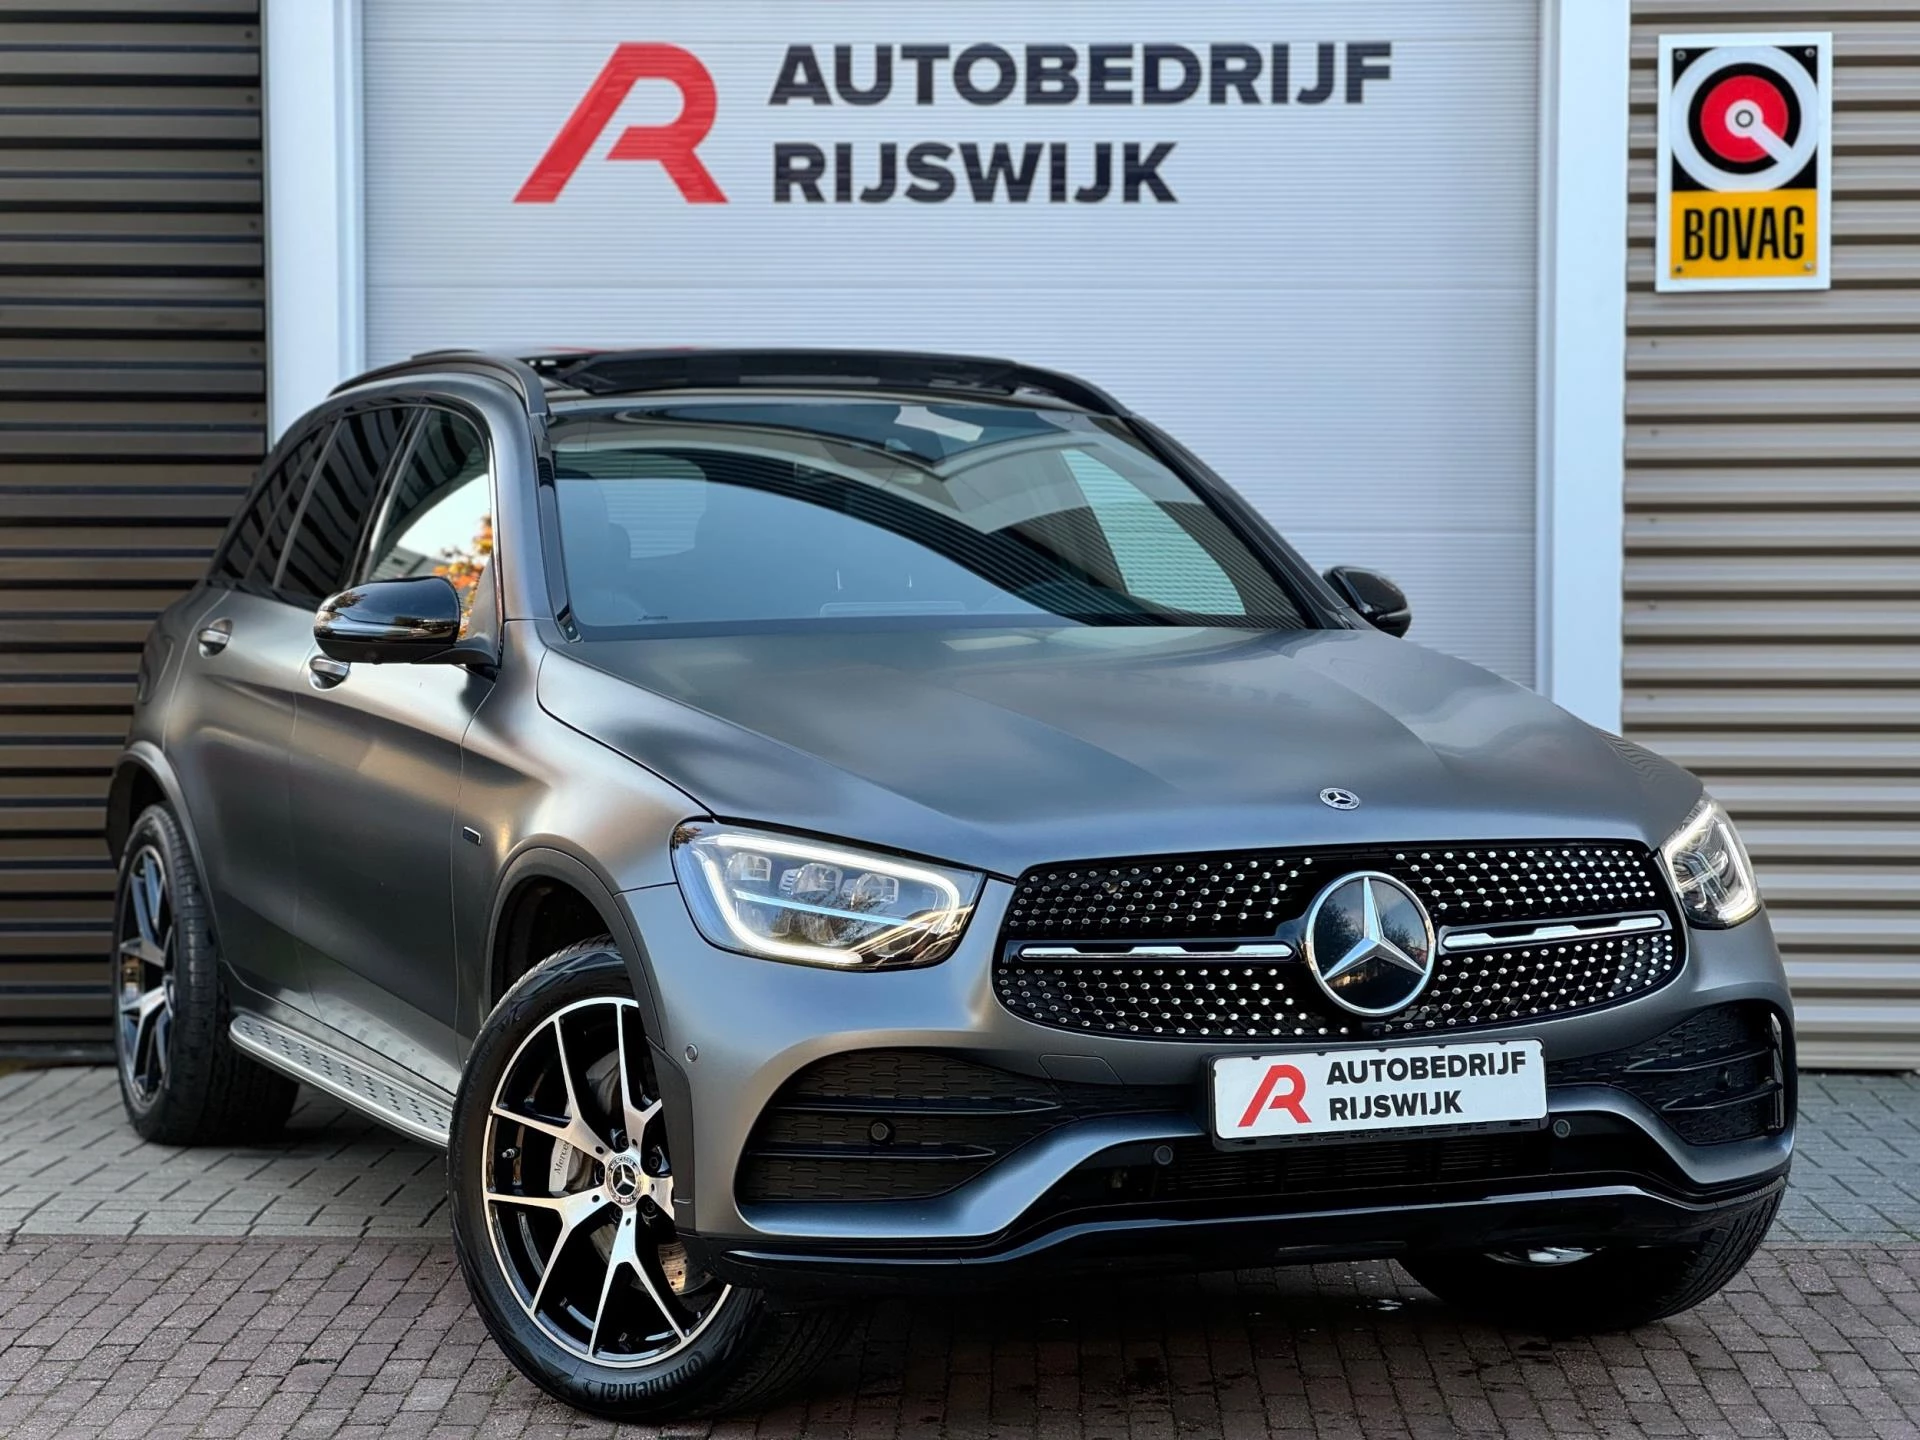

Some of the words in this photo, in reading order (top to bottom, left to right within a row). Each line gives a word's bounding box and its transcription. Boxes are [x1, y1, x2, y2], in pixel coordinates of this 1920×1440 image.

[769, 42, 1392, 106] AUTOBEDRIJF
[773, 142, 1178, 204] RIJSWIJK
[1683, 205, 1805, 262] BOVAG
[1326, 1050, 1526, 1086] AUTOBEDRIJF
[1329, 1090, 1464, 1121] RIJSWIJK
[599, 1350, 706, 1402] Continental
